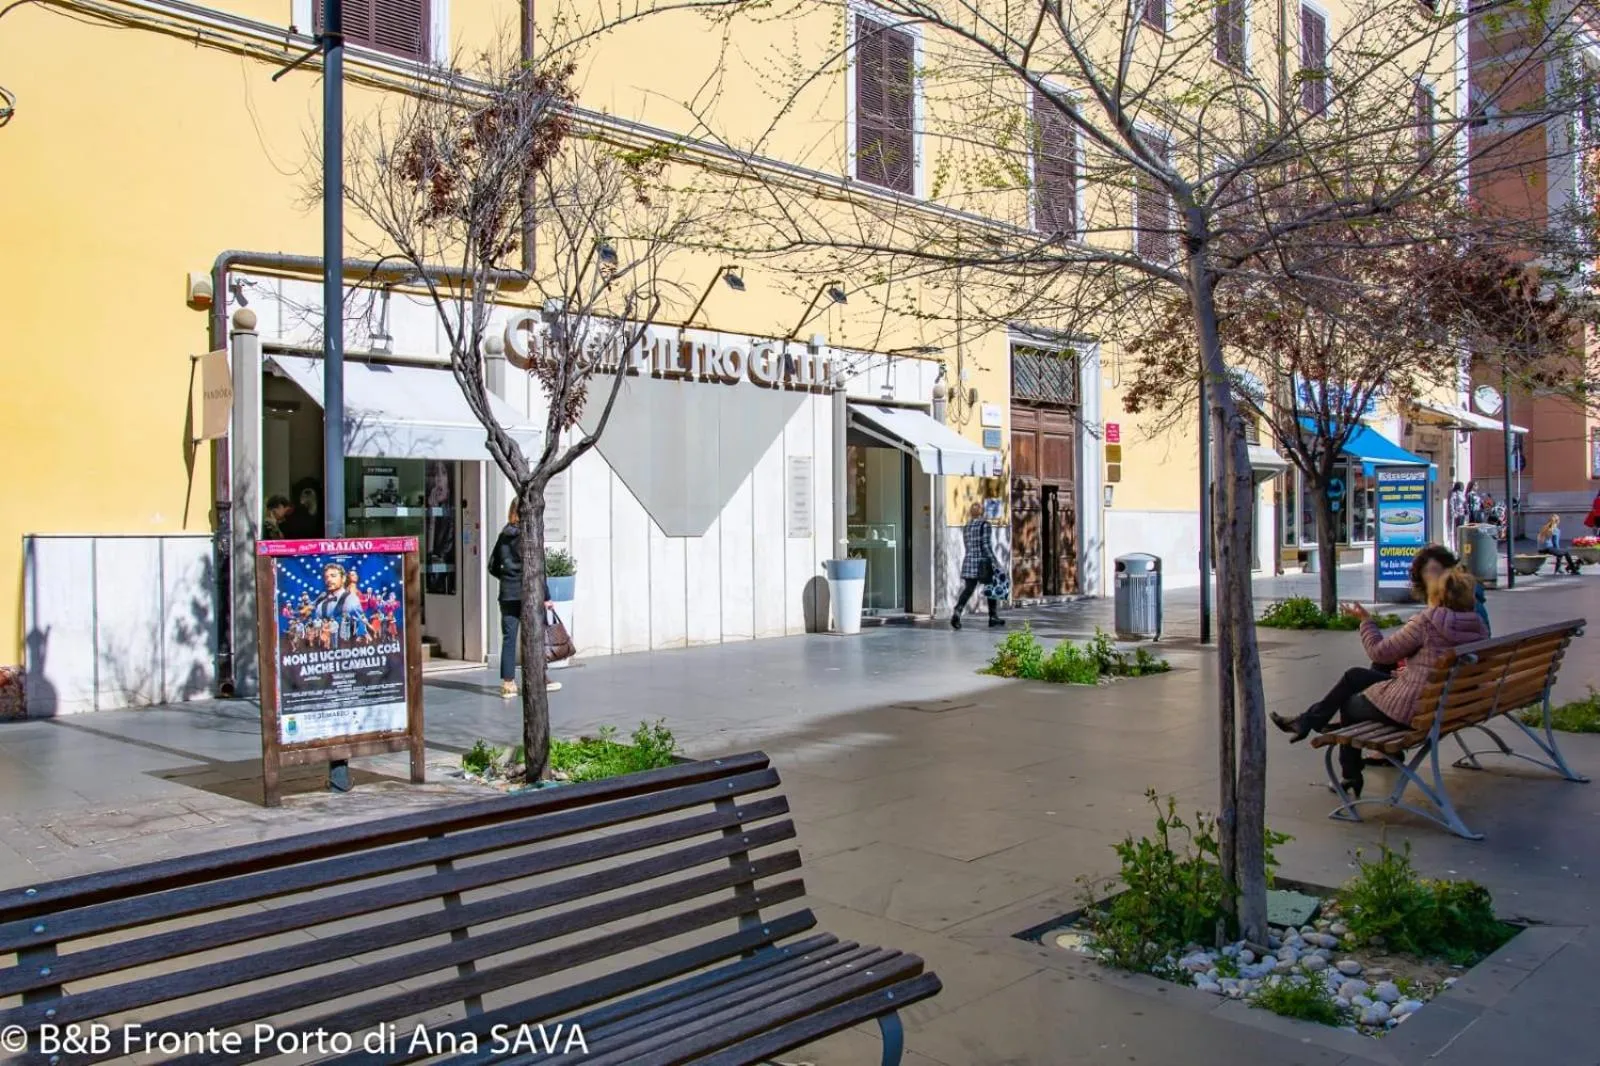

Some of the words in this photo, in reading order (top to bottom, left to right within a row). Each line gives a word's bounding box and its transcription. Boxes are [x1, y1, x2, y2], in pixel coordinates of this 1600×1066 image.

[319, 541, 373, 552] TRAIANO
[283, 653, 307, 666] NON
[309, 651, 319, 662] SI
[320, 646, 375, 661] UCCIDONO
[377, 640, 400, 653] COSÌ
[300, 662, 335, 676] ANCHE
[341, 658, 380, 670] CAVALLI
